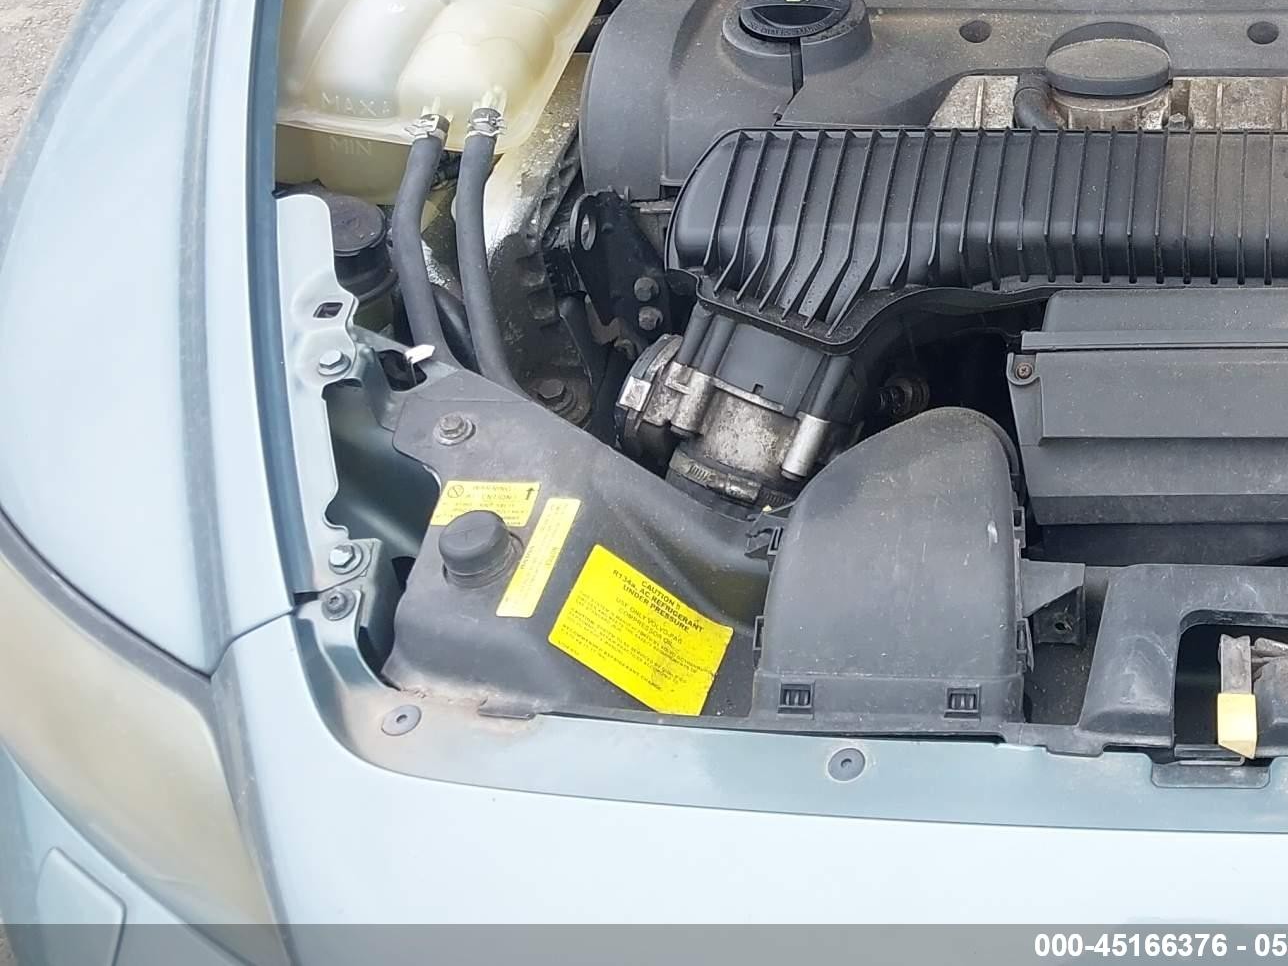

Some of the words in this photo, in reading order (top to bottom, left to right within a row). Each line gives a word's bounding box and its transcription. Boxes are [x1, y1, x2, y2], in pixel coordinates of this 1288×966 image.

[321, 91, 377, 117] MAX
[328, 135, 372, 155] MIN
[640, 579, 676, 607] CAUTION
[614, 595, 629, 609] USE
[628, 605, 647, 621] ONLY
[621, 583, 650, 606] UNDER
[648, 601, 691, 634] PRESSURE
[638, 586, 651, 599] AC
[649, 594, 705, 634] REFRIGERANT
[616, 606, 663, 640] COMPRESSOR
